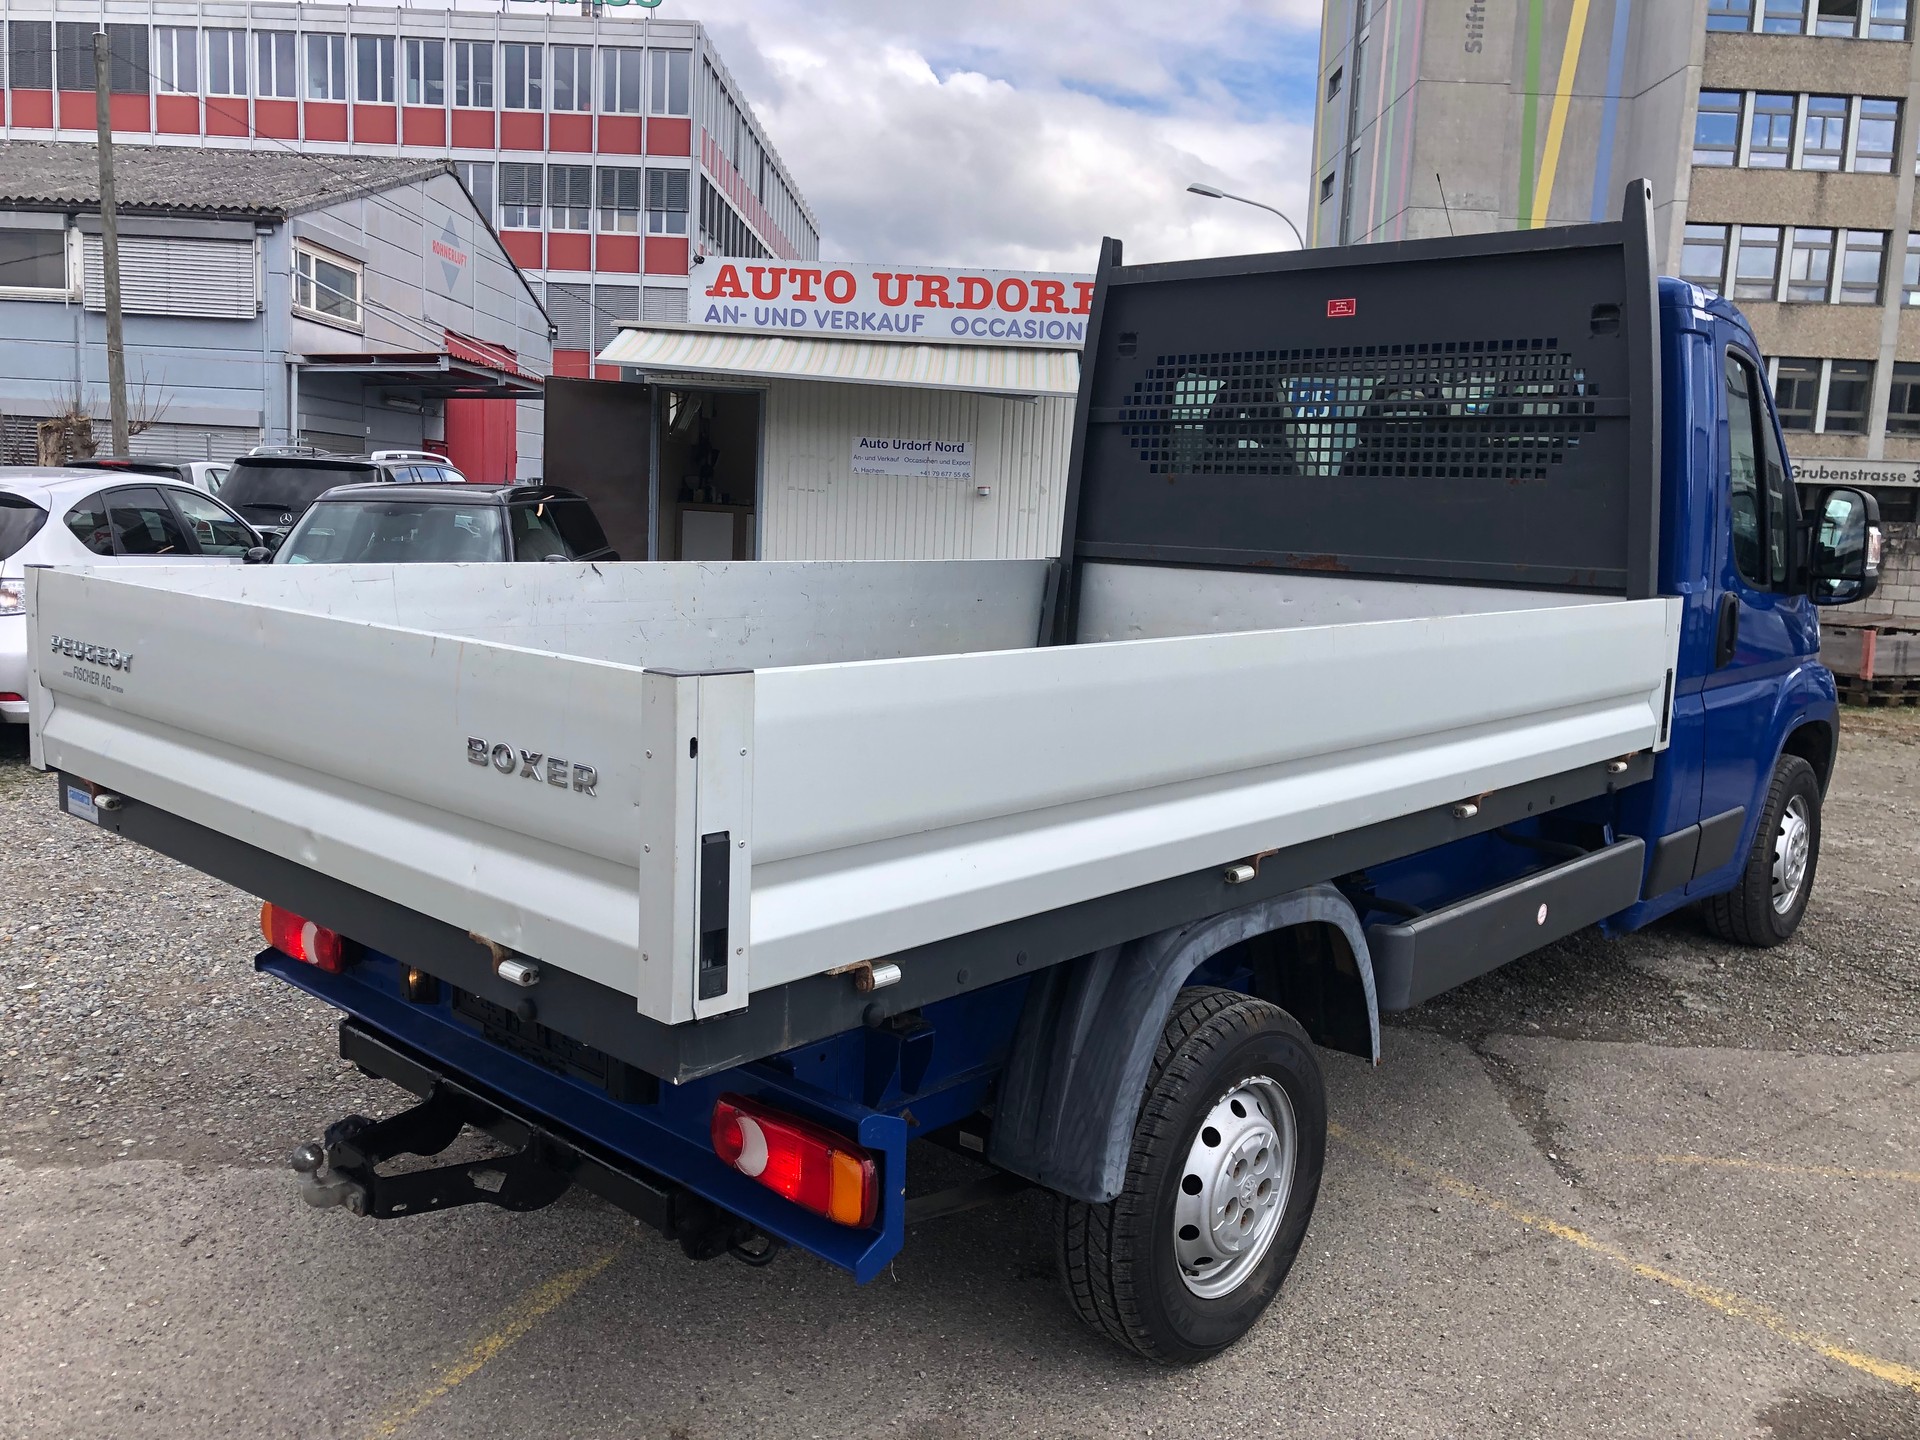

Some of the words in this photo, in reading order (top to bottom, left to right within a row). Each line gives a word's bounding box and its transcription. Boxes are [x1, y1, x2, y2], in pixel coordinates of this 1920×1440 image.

[1465, 0, 1486, 54] Stift
[705, 264, 857, 305] AUTO
[704, 304, 748, 324] AN-
[754, 306, 807, 328] UND
[814, 309, 925, 333] VERKAUF
[950, 316, 1088, 341] OCCASION
[860, 437, 889, 450] Auto
[892, 439, 932, 451] Urdorf
[935, 441, 965, 453] Nord
[877, 455, 900, 463] Verkauf
[951, 459, 971, 468] Export
[1791, 465, 1907, 483] Grubenstrasse
[51, 634, 133, 673] PEUGEOT
[72, 665, 100, 686] FISCHER
[100, 674, 112, 690] AG
[467, 735, 598, 798] BOXER
